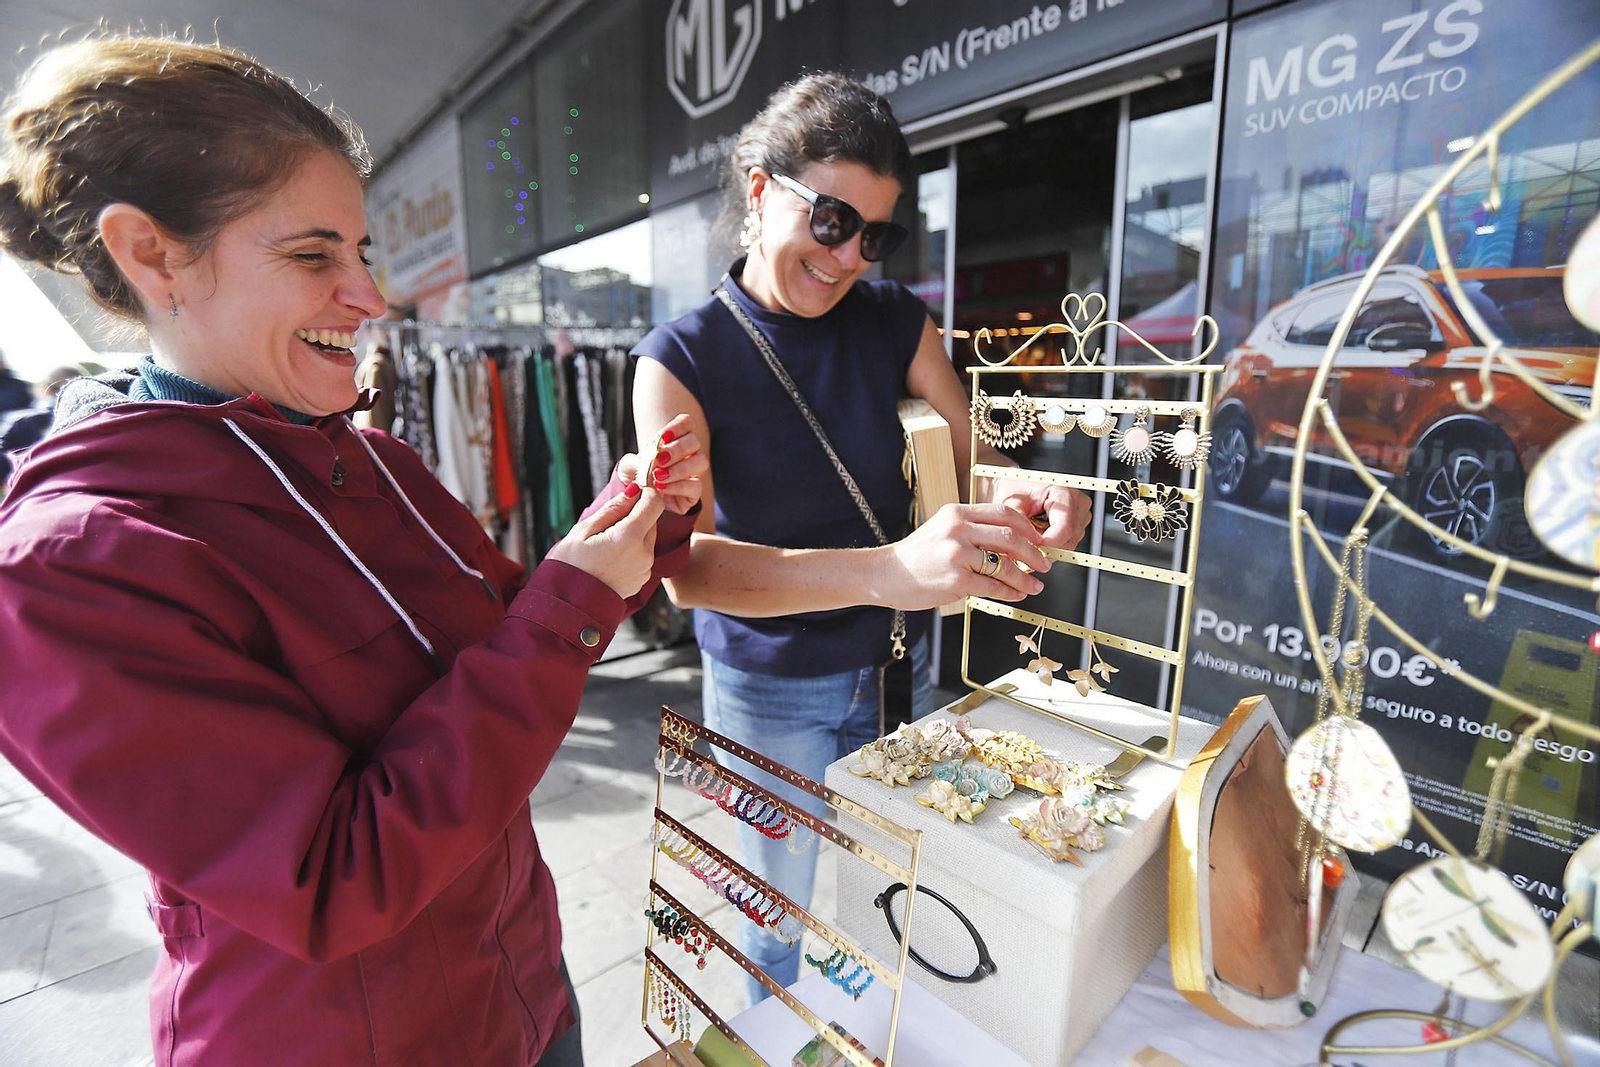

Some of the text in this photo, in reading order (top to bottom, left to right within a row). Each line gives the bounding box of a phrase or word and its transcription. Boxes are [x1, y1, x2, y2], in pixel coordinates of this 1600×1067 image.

[671, 0, 757, 107] MG
[901, 42, 950, 86] S/N
[955, 4, 1062, 69] (Frente
[1245, 0, 1483, 107] MG ZS
[1244, 66, 1467, 138] SUV COMPACTO
[1193, 608, 1252, 646] Por
[1192, 650, 1239, 675] Ahora
[1240, 664, 1271, 684] con
[1274, 673, 1298, 690] un
[1364, 695, 1436, 725] seguro
[1438, 713, 1453, 729] a
[1458, 716, 1513, 743] todo
[1517, 734, 1595, 763] resgo
[1581, 824, 1600, 835] nue
[1511, 873, 1557, 900] S/N
